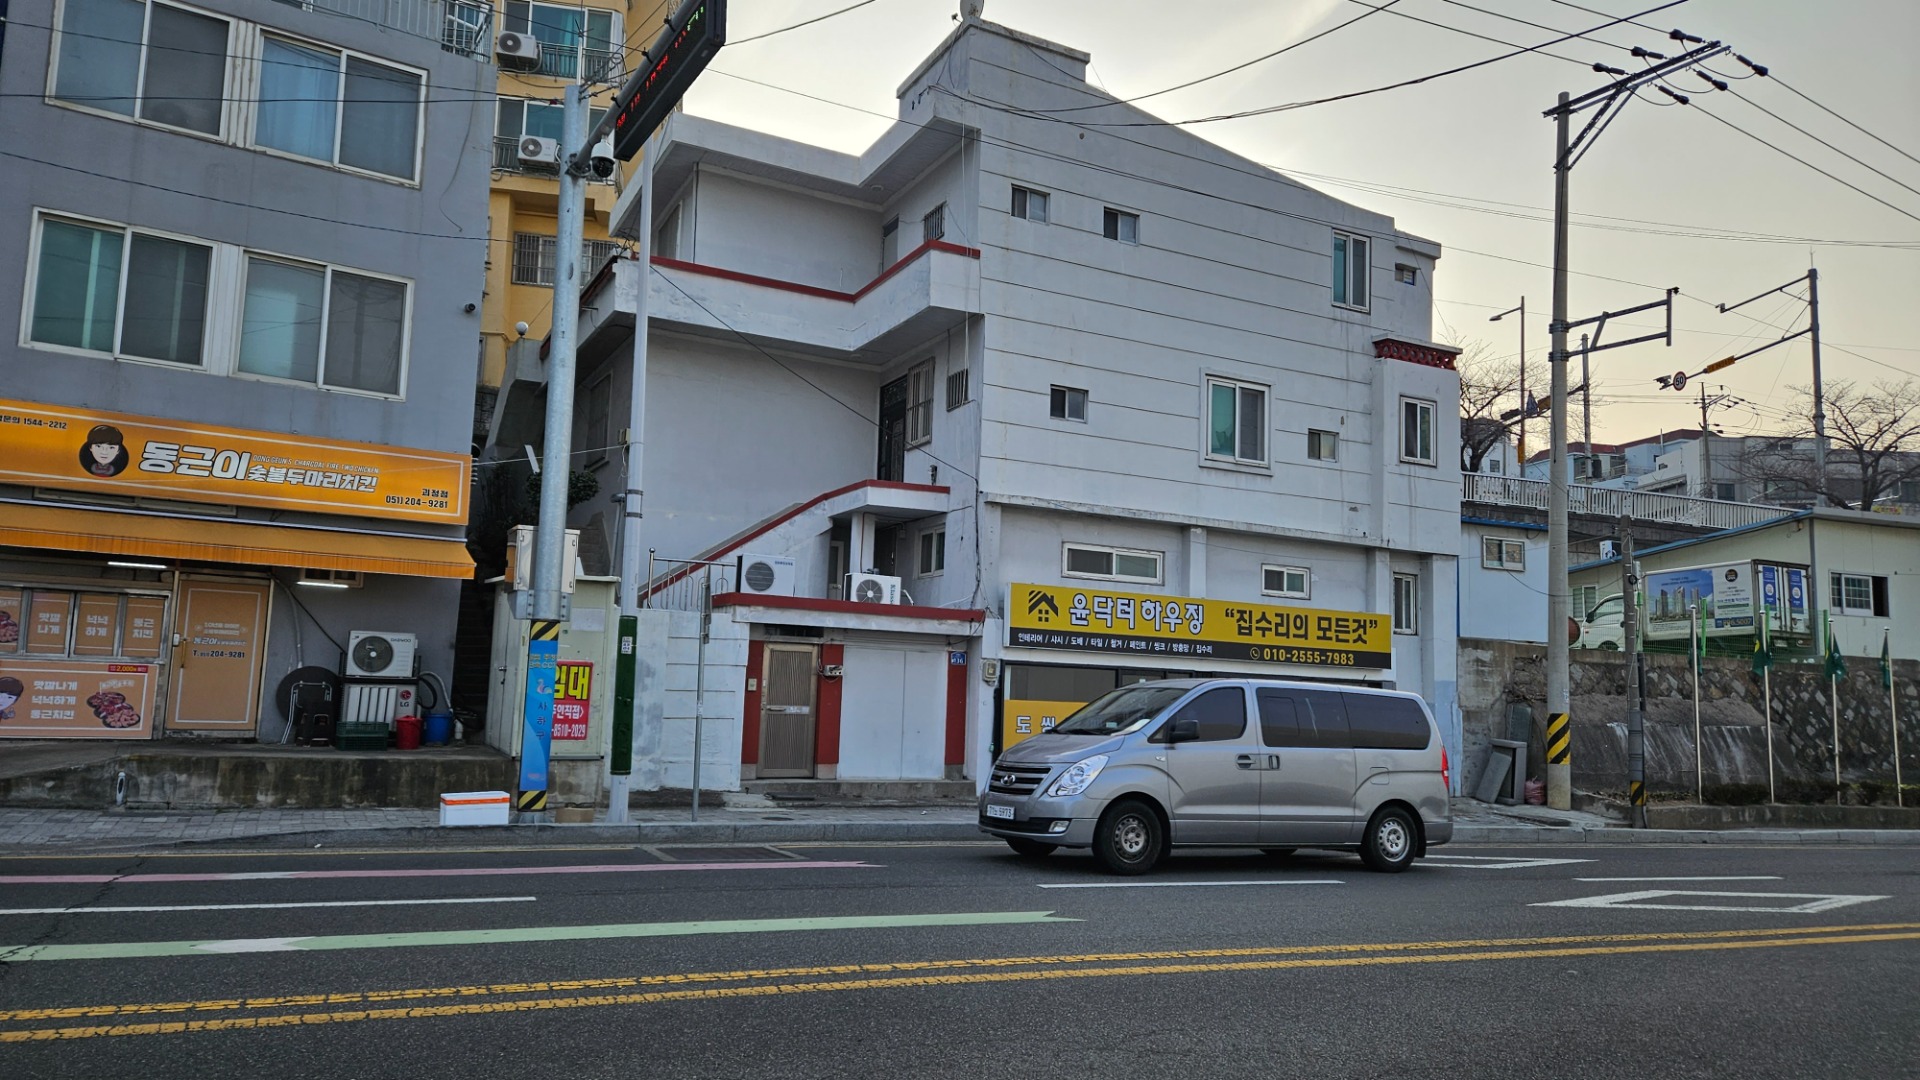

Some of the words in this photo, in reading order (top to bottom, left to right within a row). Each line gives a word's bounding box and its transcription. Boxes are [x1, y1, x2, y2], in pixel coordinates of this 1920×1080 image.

[1675, 376, 1684, 386] 50
[24, 417, 67, 429] 1544-2212
[138, 441, 252, 481] 동근이
[294, 459, 324, 468] CHARCOAL
[327, 462, 338, 470] FIRE
[354, 464, 380, 474] CHICKEN
[247, 464, 379, 493] 숯불두마리치킨
[422, 488, 448, 498] 괴정점
[405, 497, 448, 509] 204-9281
[1069, 593, 1136, 630] 윤닥터
[1141, 599, 1205, 636] 하우징
[37, 624, 60, 634] 나게
[85, 626, 107, 637] 하게
[1018, 633, 1043, 643] 인테리어
[1051, 634, 1063, 645] 샤시
[1070, 636, 1083, 646] 도배
[1090, 637, 1103, 648] 타일
[1111, 638, 1122, 649] 철거
[1129, 640, 1147, 650] 페인트
[1154, 641, 1166, 651] 씽크
[1172, 642, 1189, 653] 방충망
[1196, 644, 1213, 654] 집수리
[1263, 648, 1355, 665] 010-2555-7983
[536, 702, 547, 740] 사하구
[1016, 715, 1031, 734] 도
